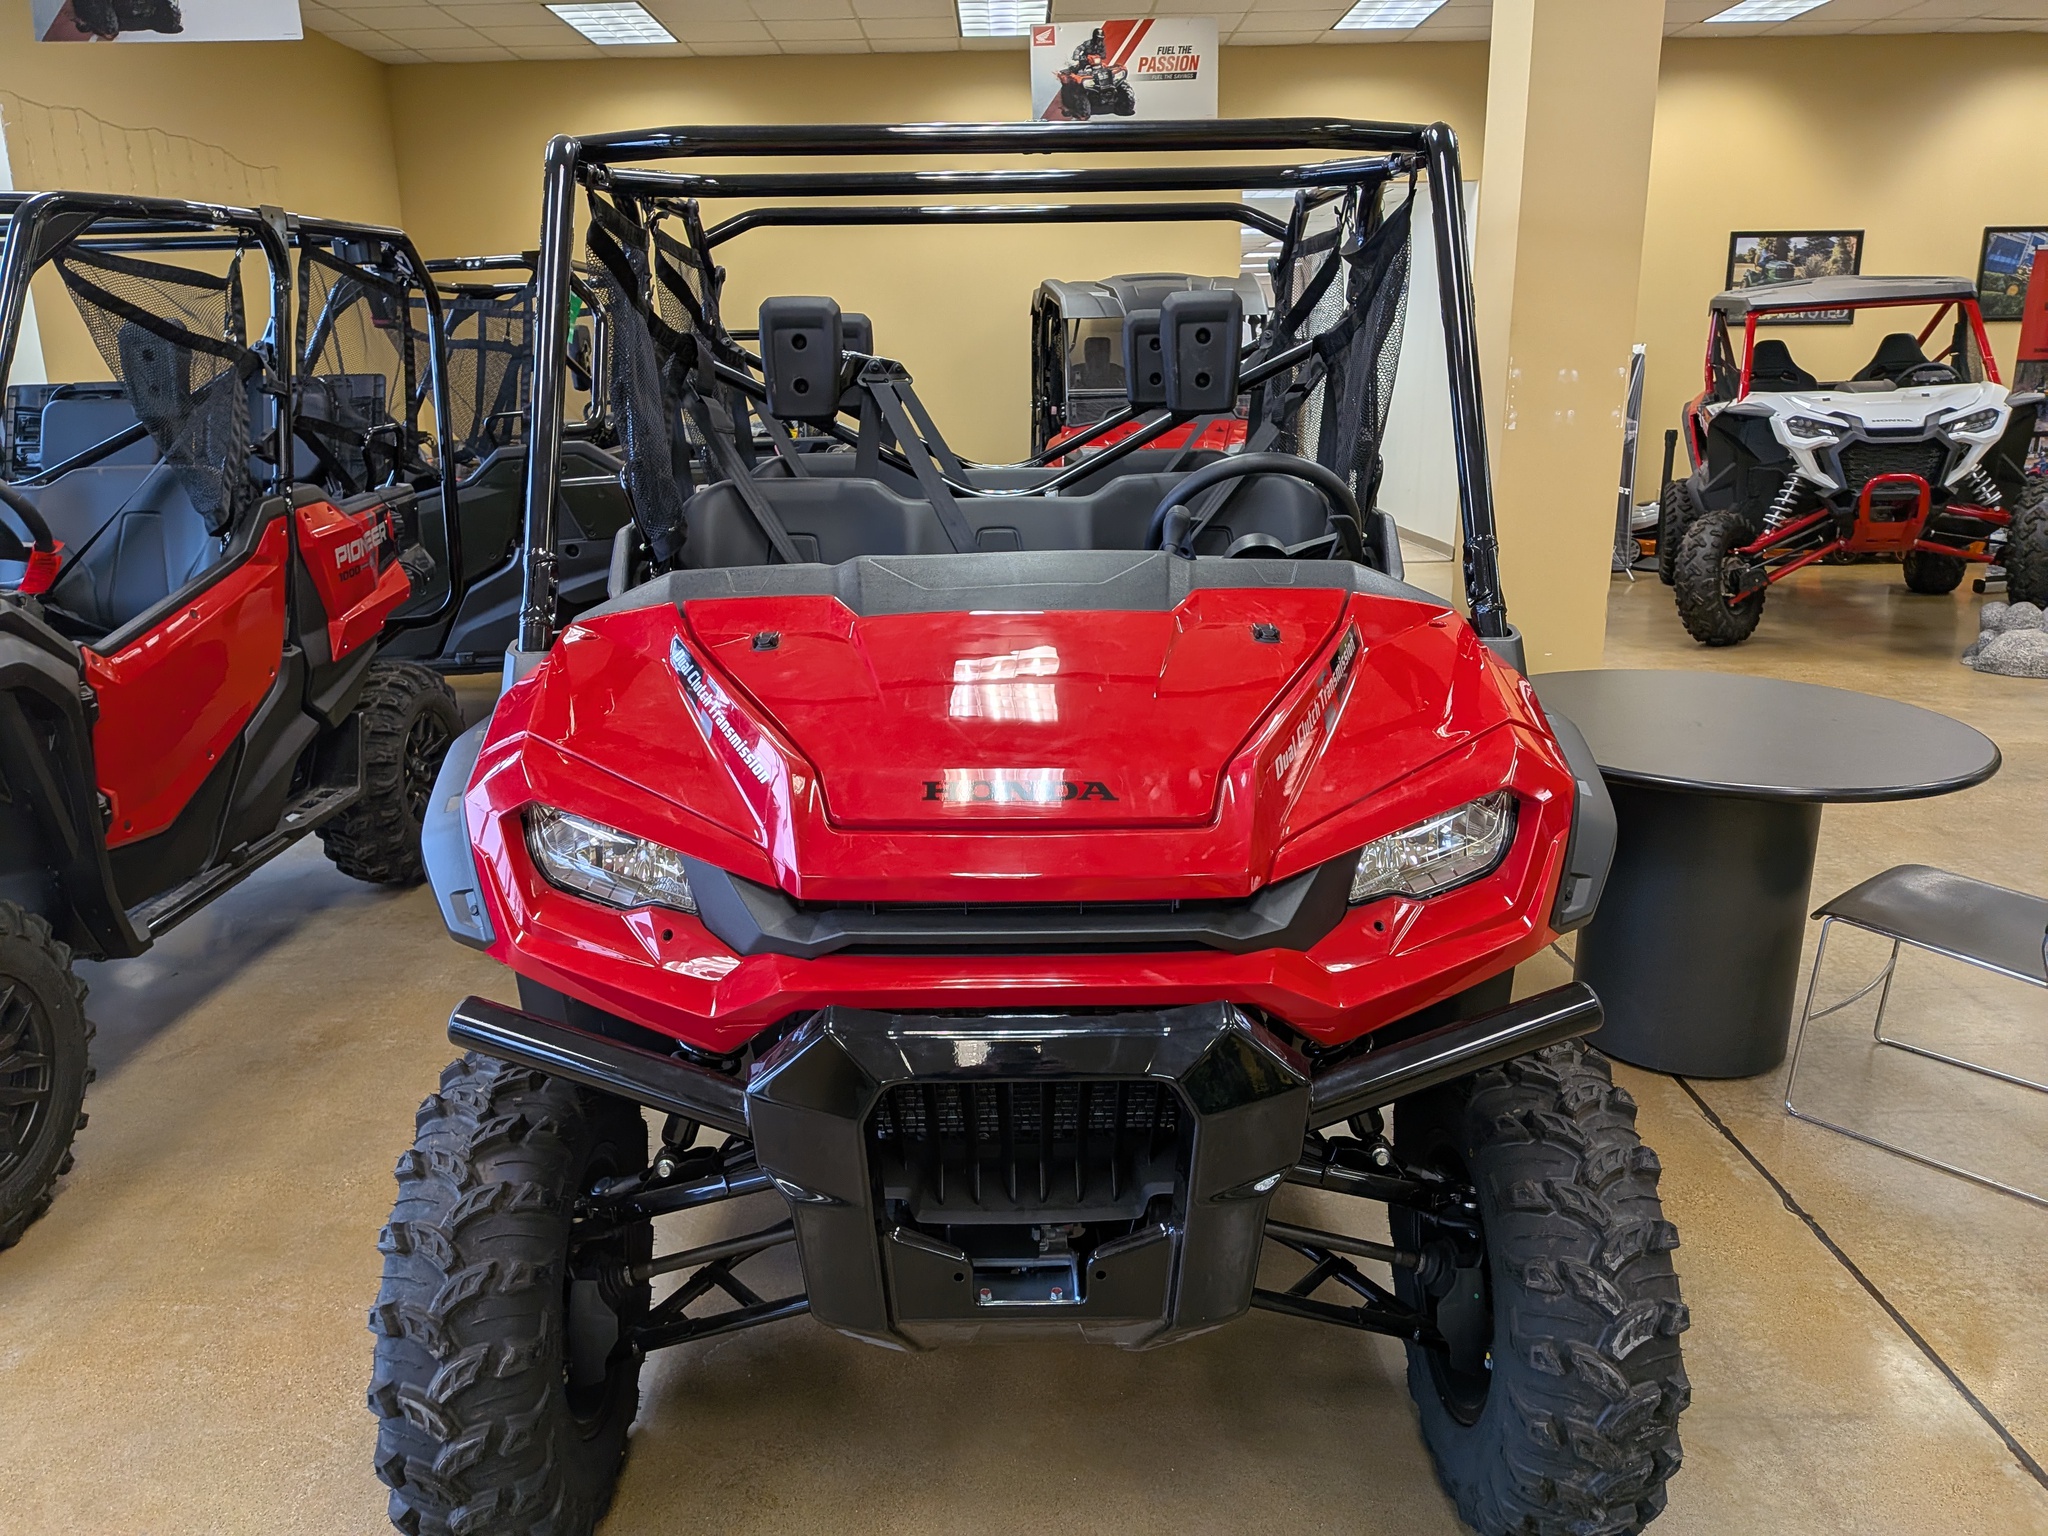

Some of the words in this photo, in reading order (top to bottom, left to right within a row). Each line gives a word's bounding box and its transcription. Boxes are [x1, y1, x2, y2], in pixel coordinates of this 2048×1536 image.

[1157, 46, 1175, 55] FUEL
[1178, 45, 1192, 54] THE
[1138, 55, 1200, 72] PASSION
[335, 522, 387, 569] PIONEER
[339, 565, 361, 582] 1000
[672, 648, 695, 676] Dual
[687, 670, 713, 708] Clutch
[708, 699, 770, 785] Transmission
[1274, 732, 1297, 782] Dual
[1296, 699, 1321, 749] Clutch
[1317, 637, 1357, 710] Transmission
[921, 780, 1120, 802] HONDA
